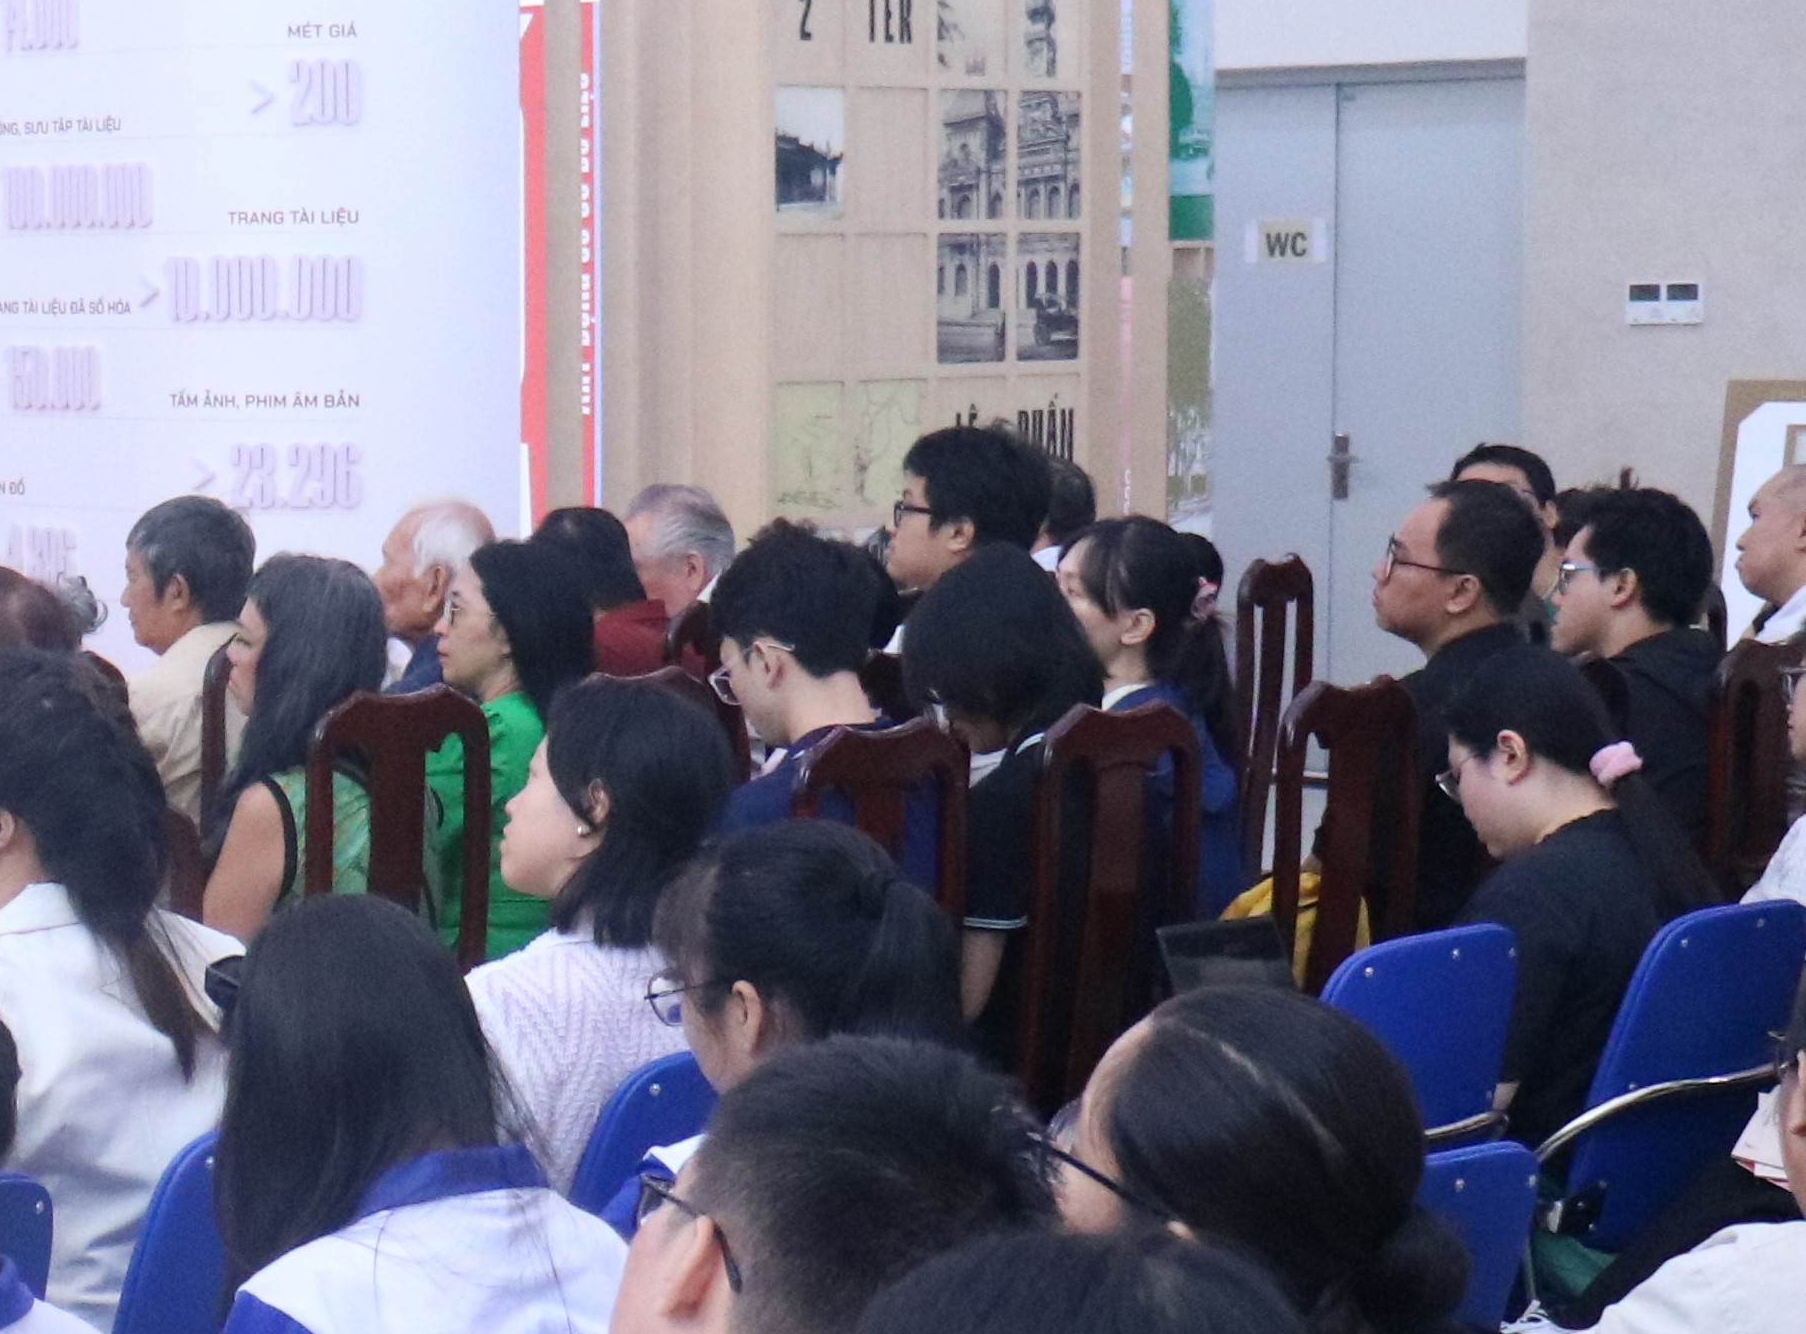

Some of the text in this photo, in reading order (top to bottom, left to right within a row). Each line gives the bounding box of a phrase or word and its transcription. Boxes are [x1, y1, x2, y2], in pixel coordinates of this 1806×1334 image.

[287, 21, 357, 38] MÉT GIÁ
[288, 58, 364, 127] 200
[77, 117, 93, 133] TÀI
[96, 114, 121, 134] LIỆU
[228, 205, 359, 227] TRANG TÀI LIỆU
[1265, 232, 1307, 259] WC
[23, 298, 38, 315] TÀI
[41, 297, 66, 316] LIỆU
[89, 295, 105, 315] SỐ
[108, 297, 131, 315] HÓA
[169, 389, 198, 408] TẤM
[245, 394, 287, 409] PHIM
[292, 391, 318, 408] ÂM
[324, 389, 360, 409] BẢN
[230, 441, 364, 509] 23.296
